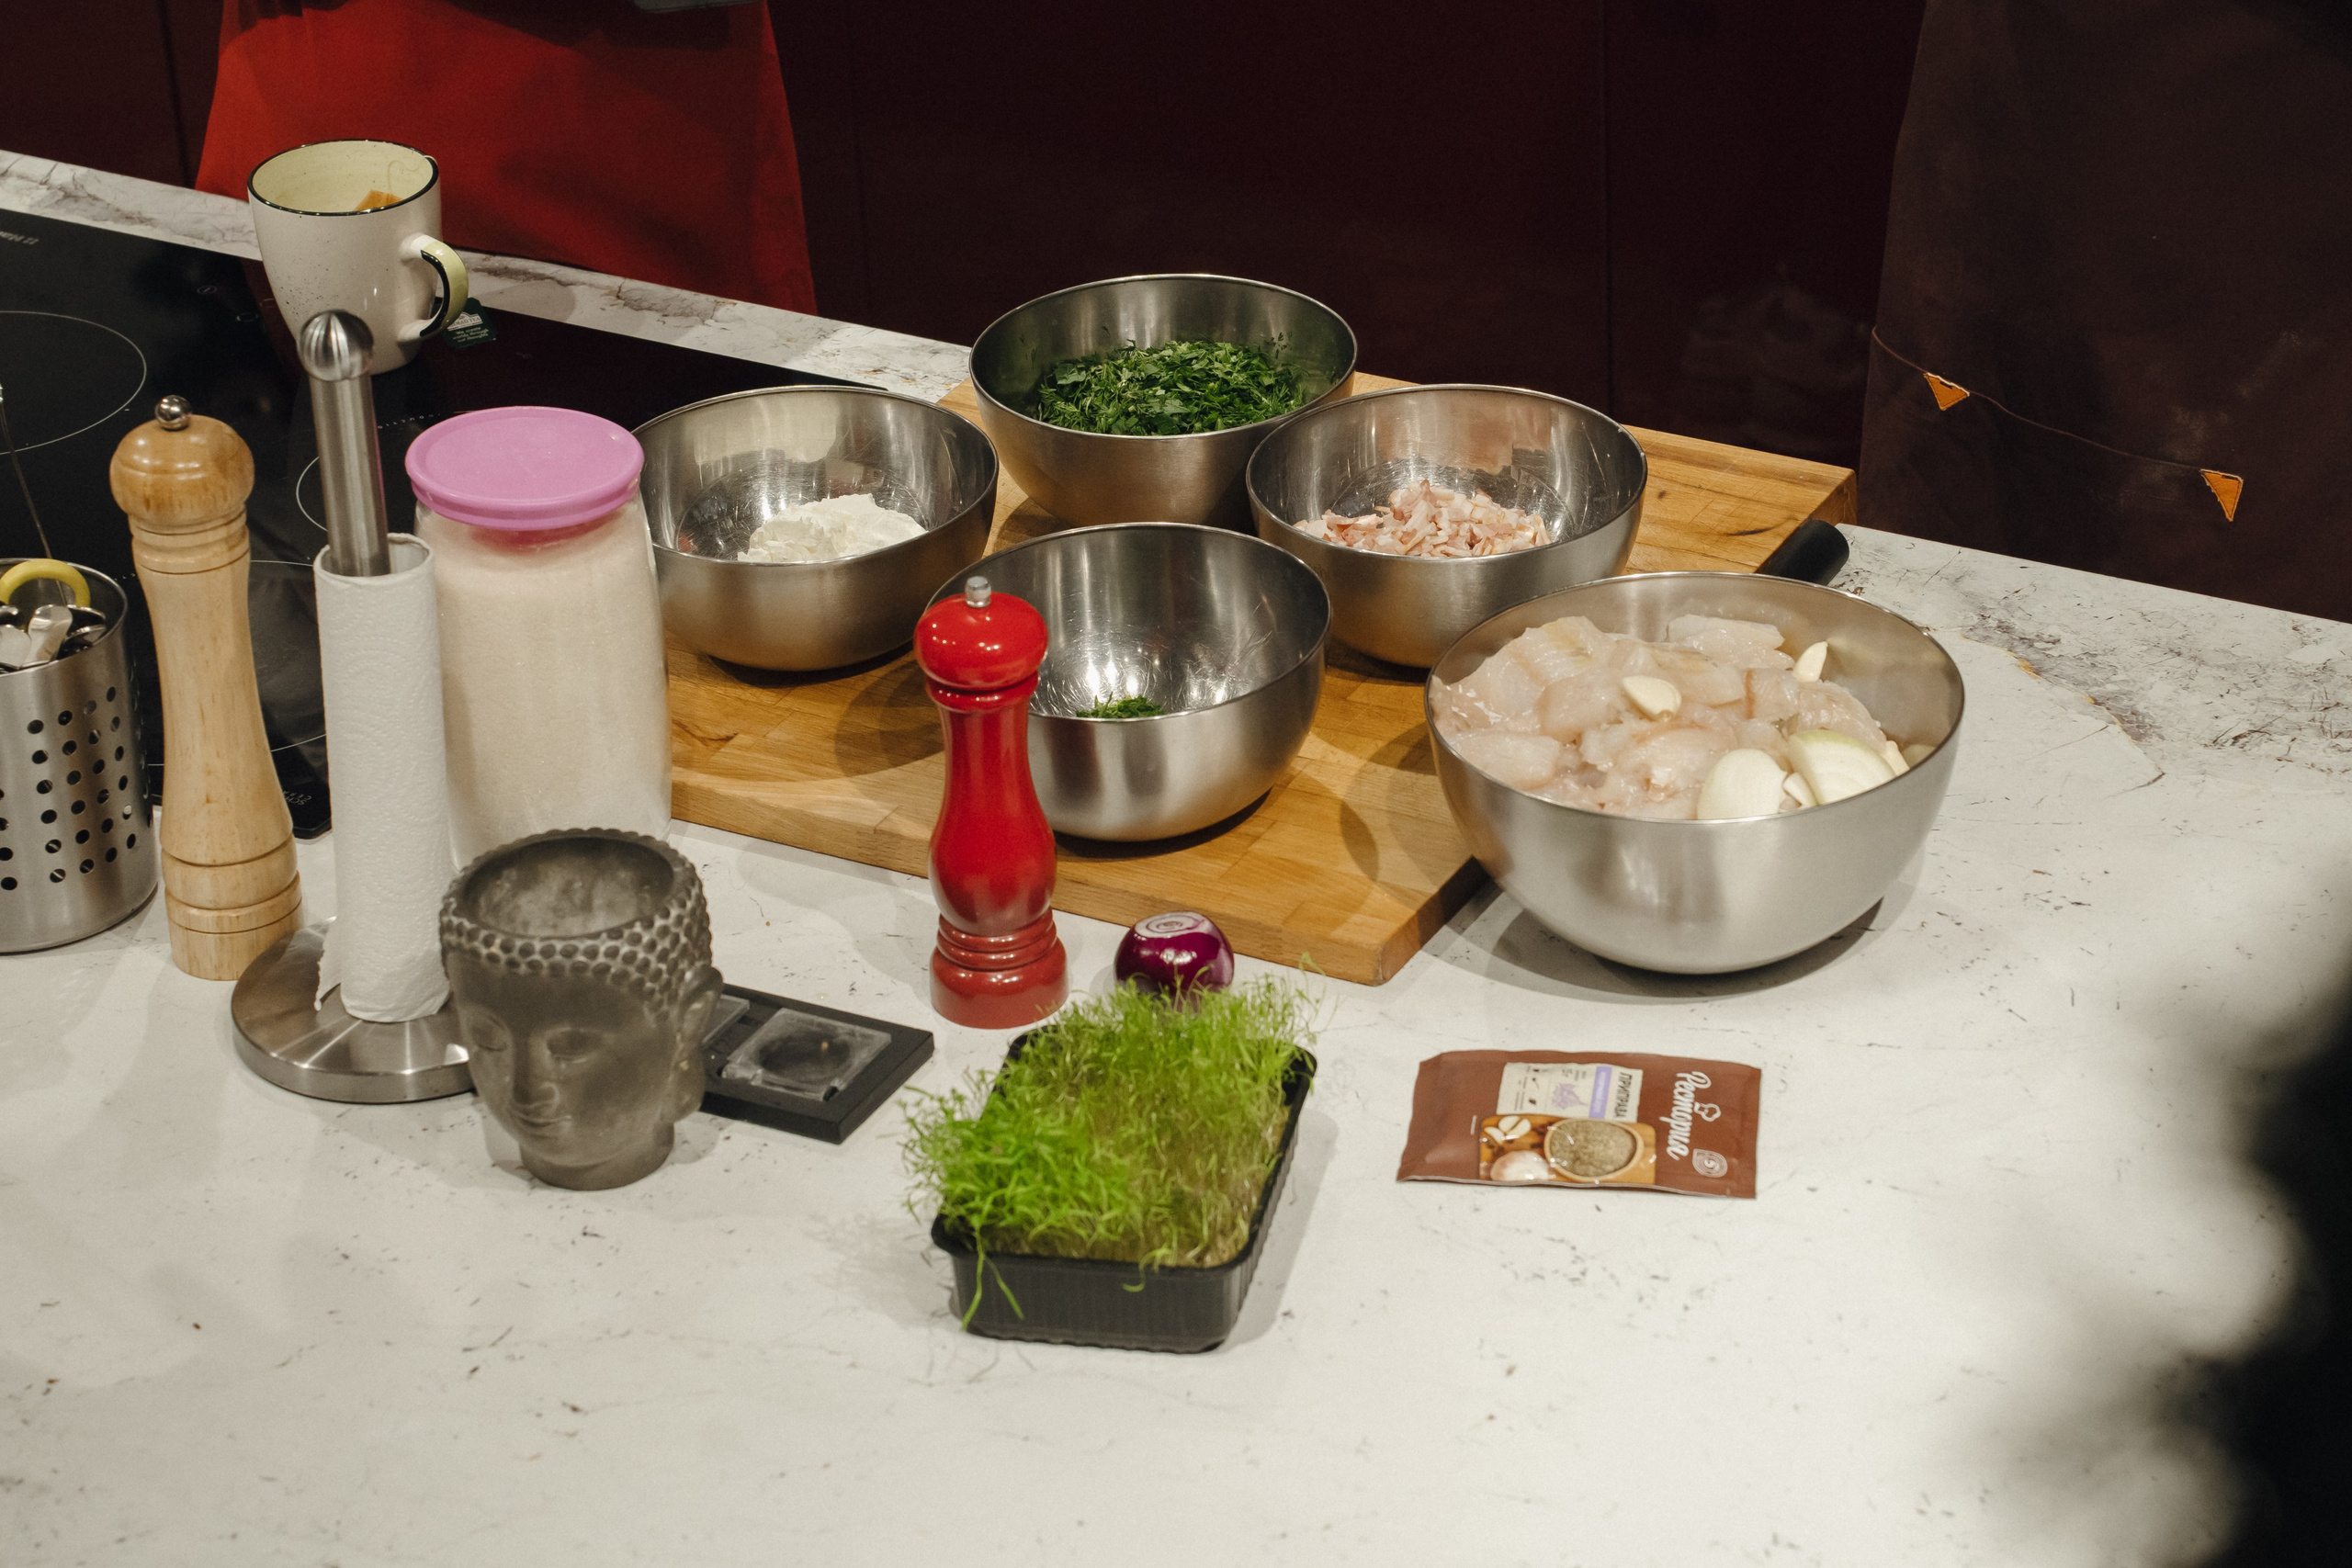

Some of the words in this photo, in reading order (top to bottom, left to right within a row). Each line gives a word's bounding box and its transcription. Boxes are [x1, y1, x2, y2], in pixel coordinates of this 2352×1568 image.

[378, 412, 441, 429] INDUCTIO
[1614, 1071, 1633, 1119] ПРИПРАВА
[1658, 1070, 1712, 1161] Рестория
